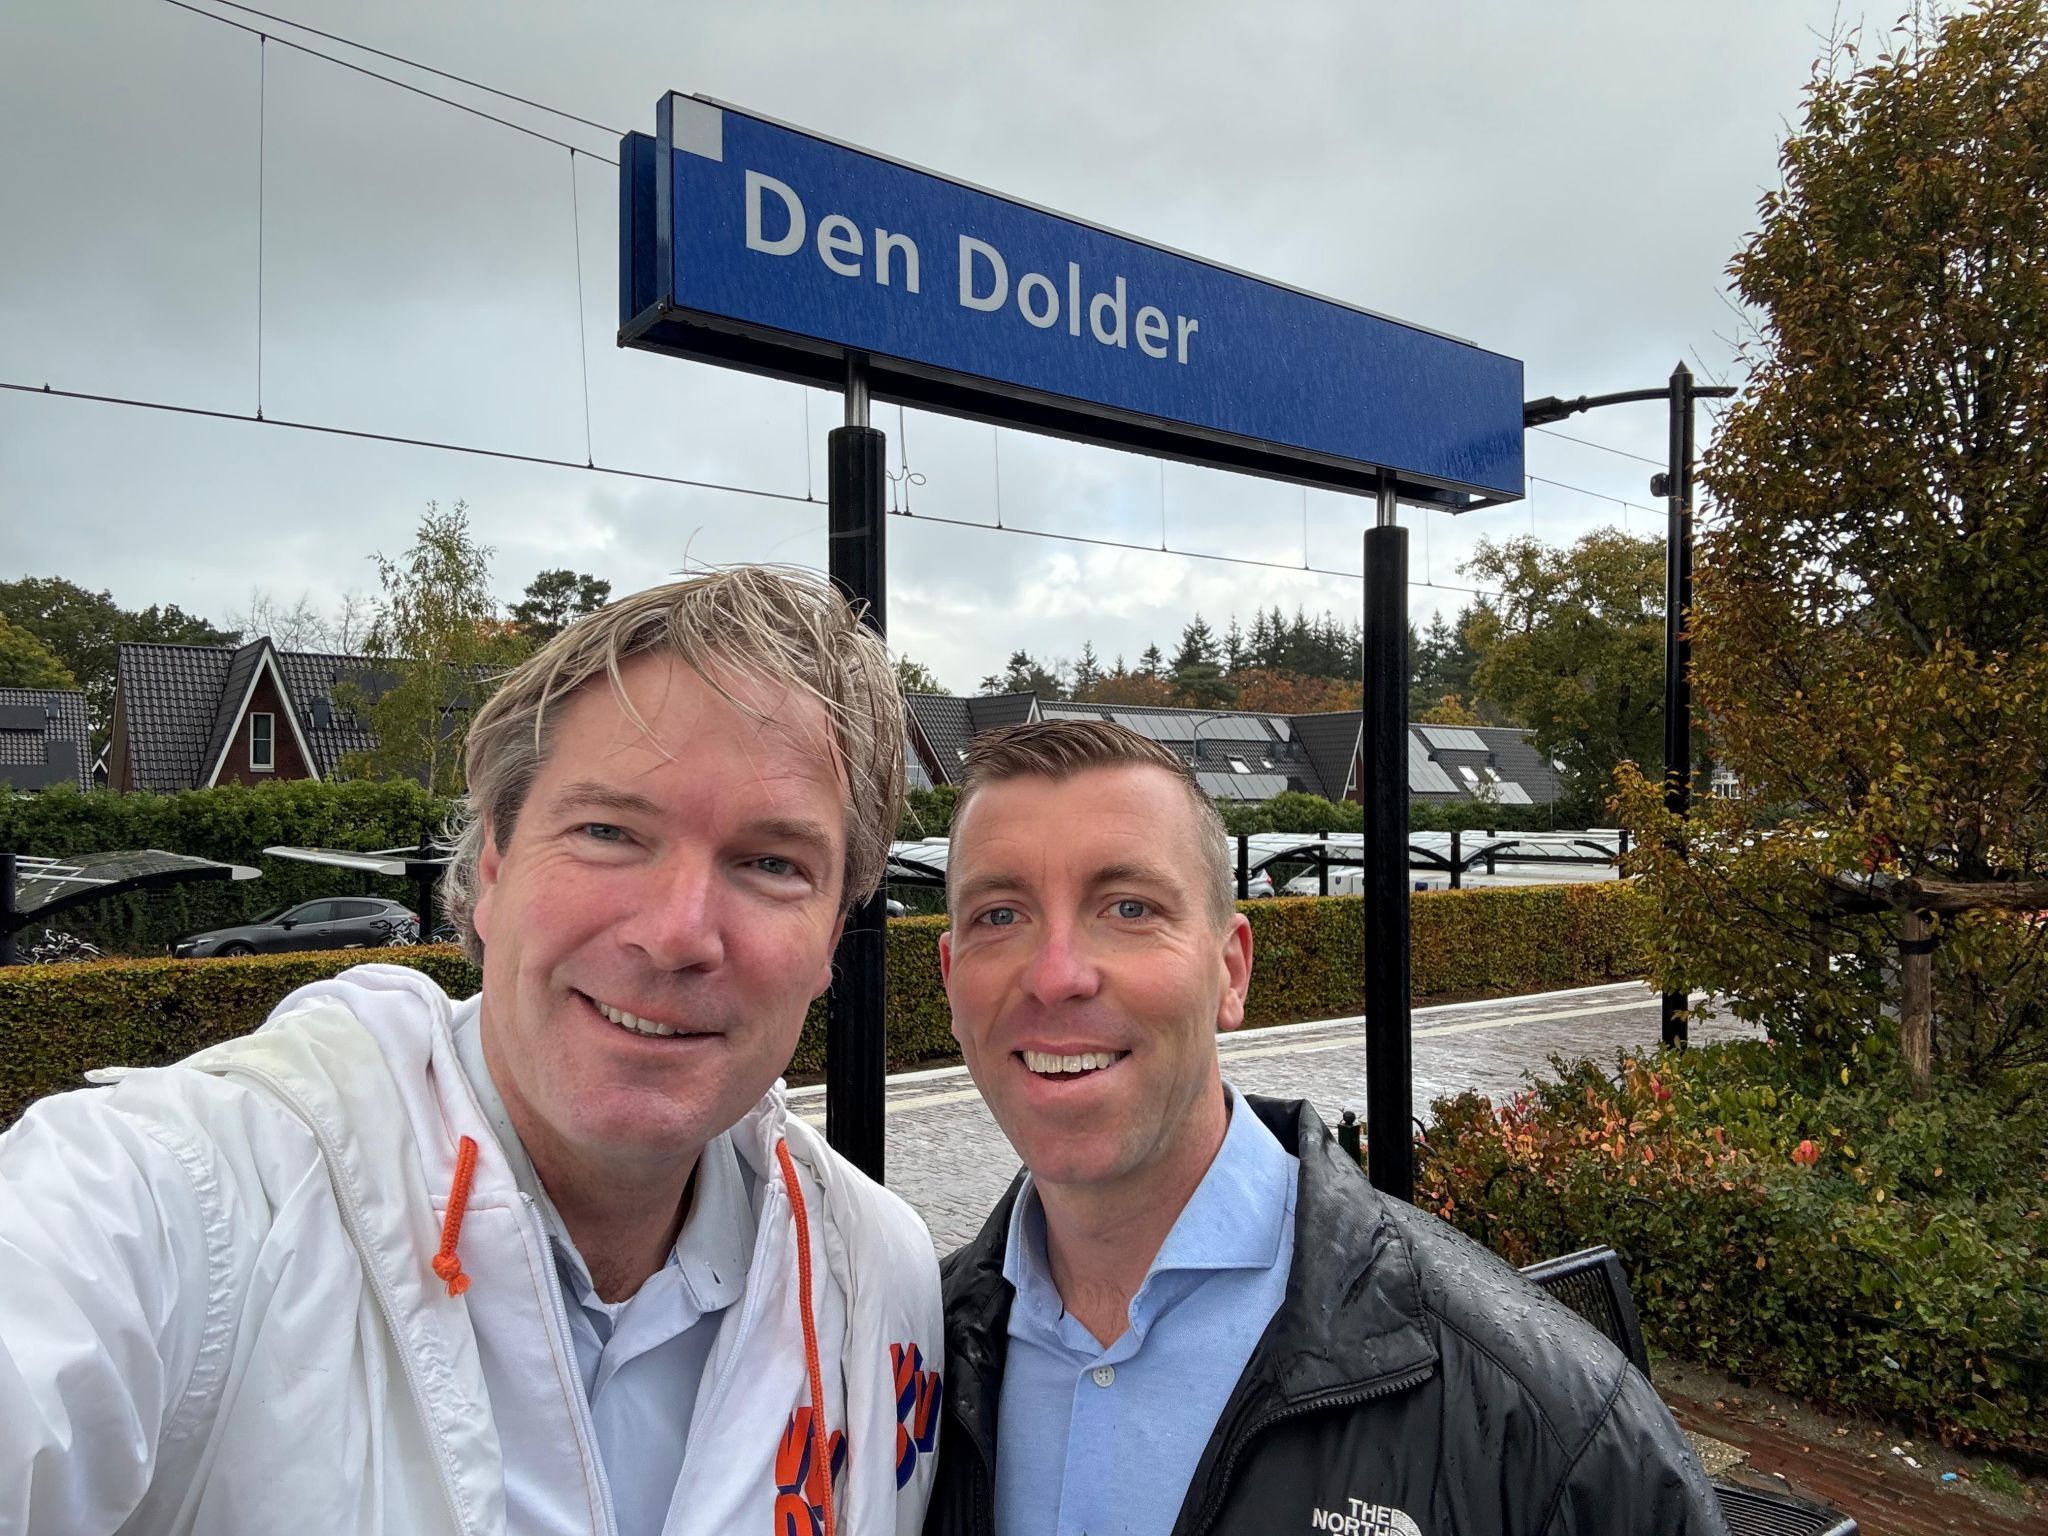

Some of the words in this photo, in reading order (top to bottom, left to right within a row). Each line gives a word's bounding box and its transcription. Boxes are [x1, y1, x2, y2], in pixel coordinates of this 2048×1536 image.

[744, 169, 920, 294] Den
[959, 234, 1200, 365] Dolder
[1348, 1497, 1392, 1526] THE
